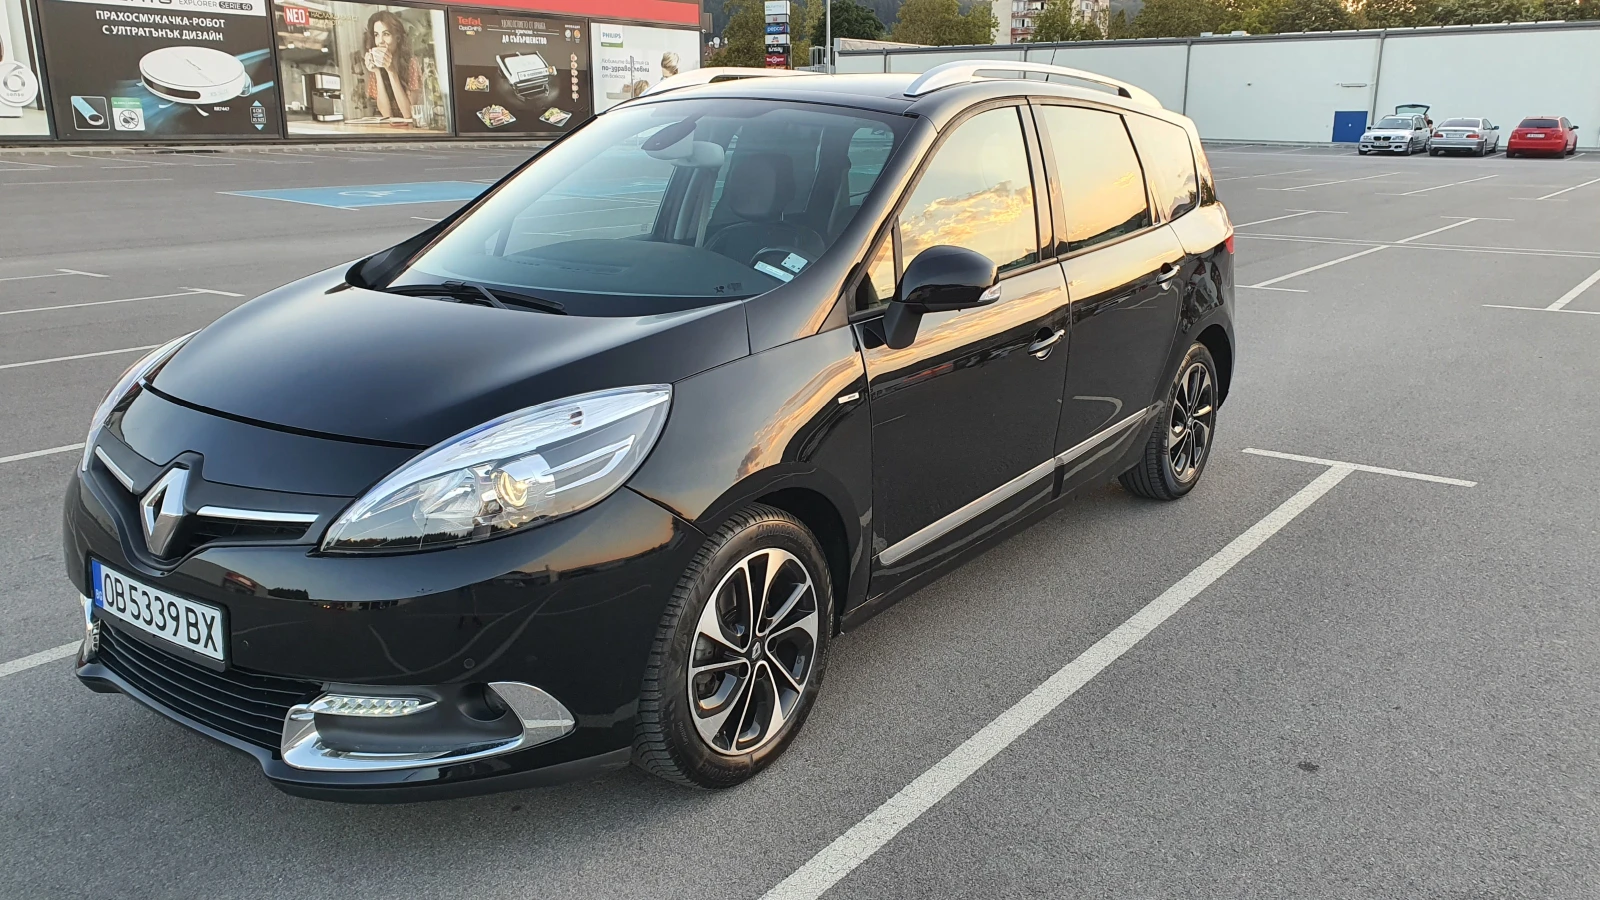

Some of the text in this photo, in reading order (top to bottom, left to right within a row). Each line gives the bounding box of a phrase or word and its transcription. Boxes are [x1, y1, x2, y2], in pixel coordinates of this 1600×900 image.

[220, 2, 240, 10] SERIE
[242, 3, 253, 11] 60
[95, 10, 226, 28] ПРАХОСМУКАЧКА-РОБОТ
[457, 16, 483, 26] Tefal
[112, 26, 180, 39] УЛТРАТЪНЪК
[182, 30, 224, 41] ДИЗАЙН
